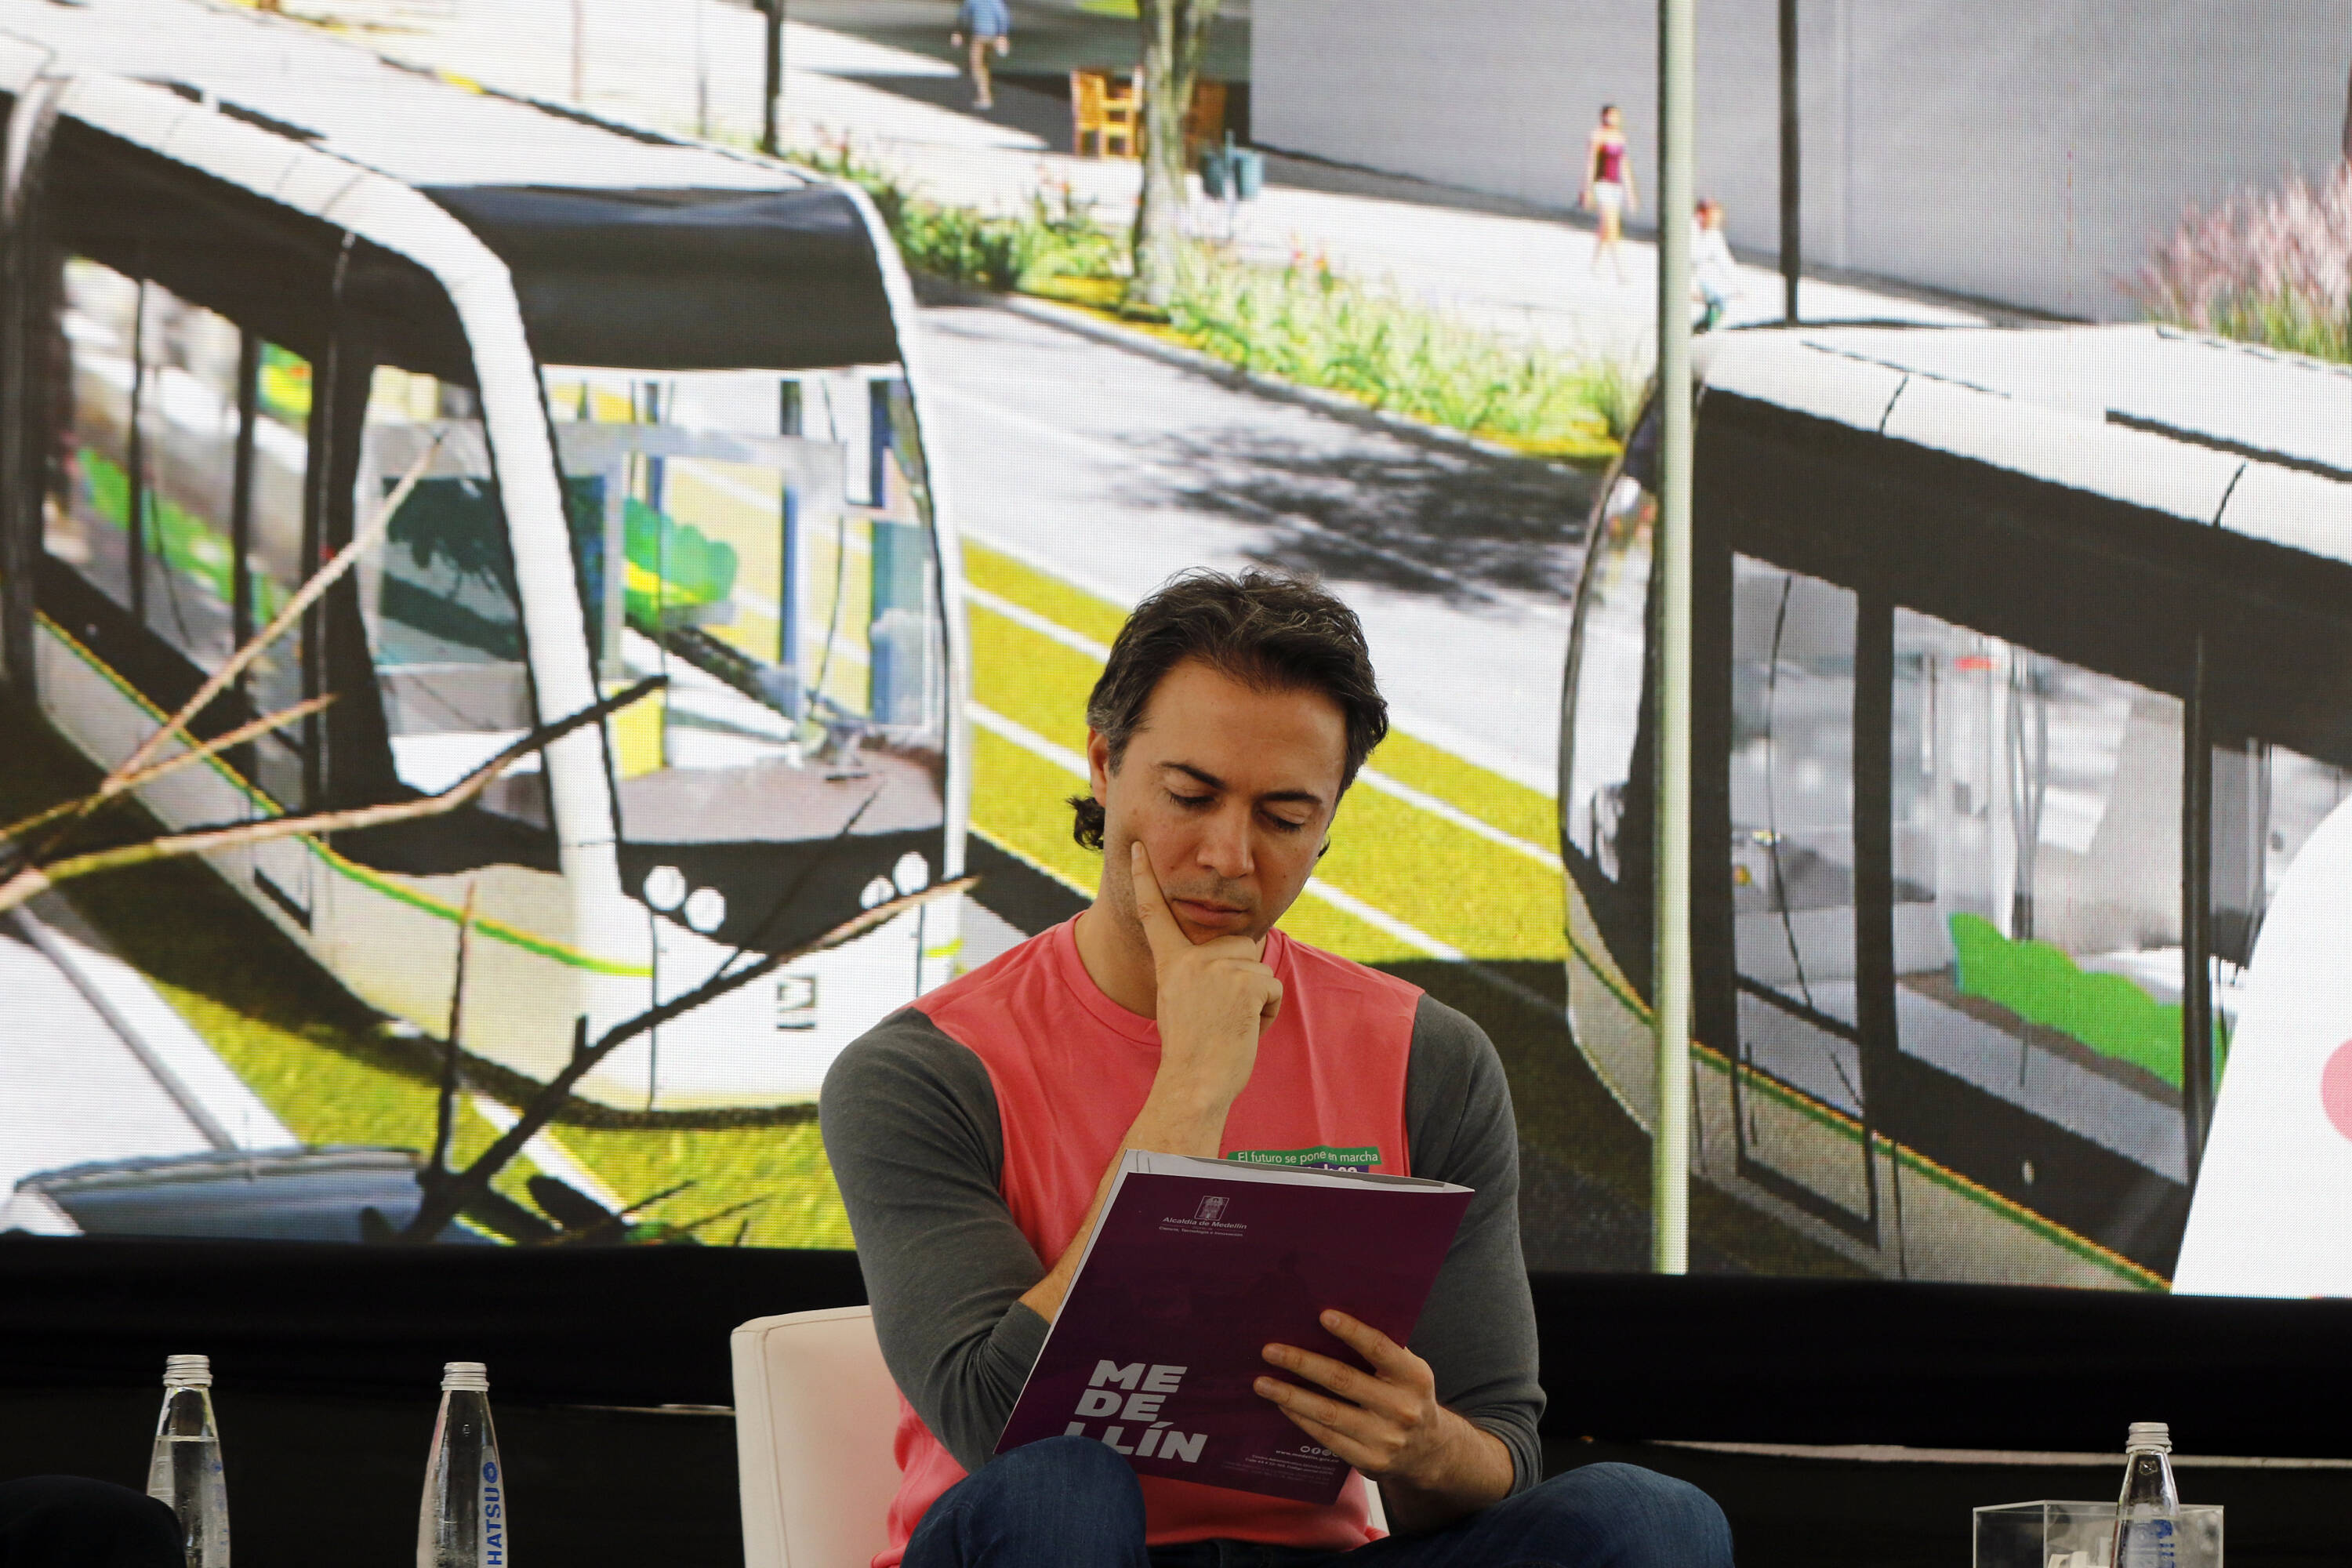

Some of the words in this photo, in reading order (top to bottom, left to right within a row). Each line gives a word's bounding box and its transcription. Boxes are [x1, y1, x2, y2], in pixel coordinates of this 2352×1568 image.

[1237, 1152, 1248, 1162] El
[1250, 1151, 1283, 1163] futuro
[1285, 1155, 1297, 1164] se
[1300, 1151, 1327, 1165] pone
[1328, 1152, 1338, 1161] en
[1340, 1151, 1378, 1162] marcha
[1087, 1359, 1188, 1393] ME
[1074, 1388, 1167, 1421] DE
[484, 1487, 503, 1566] HATSU
